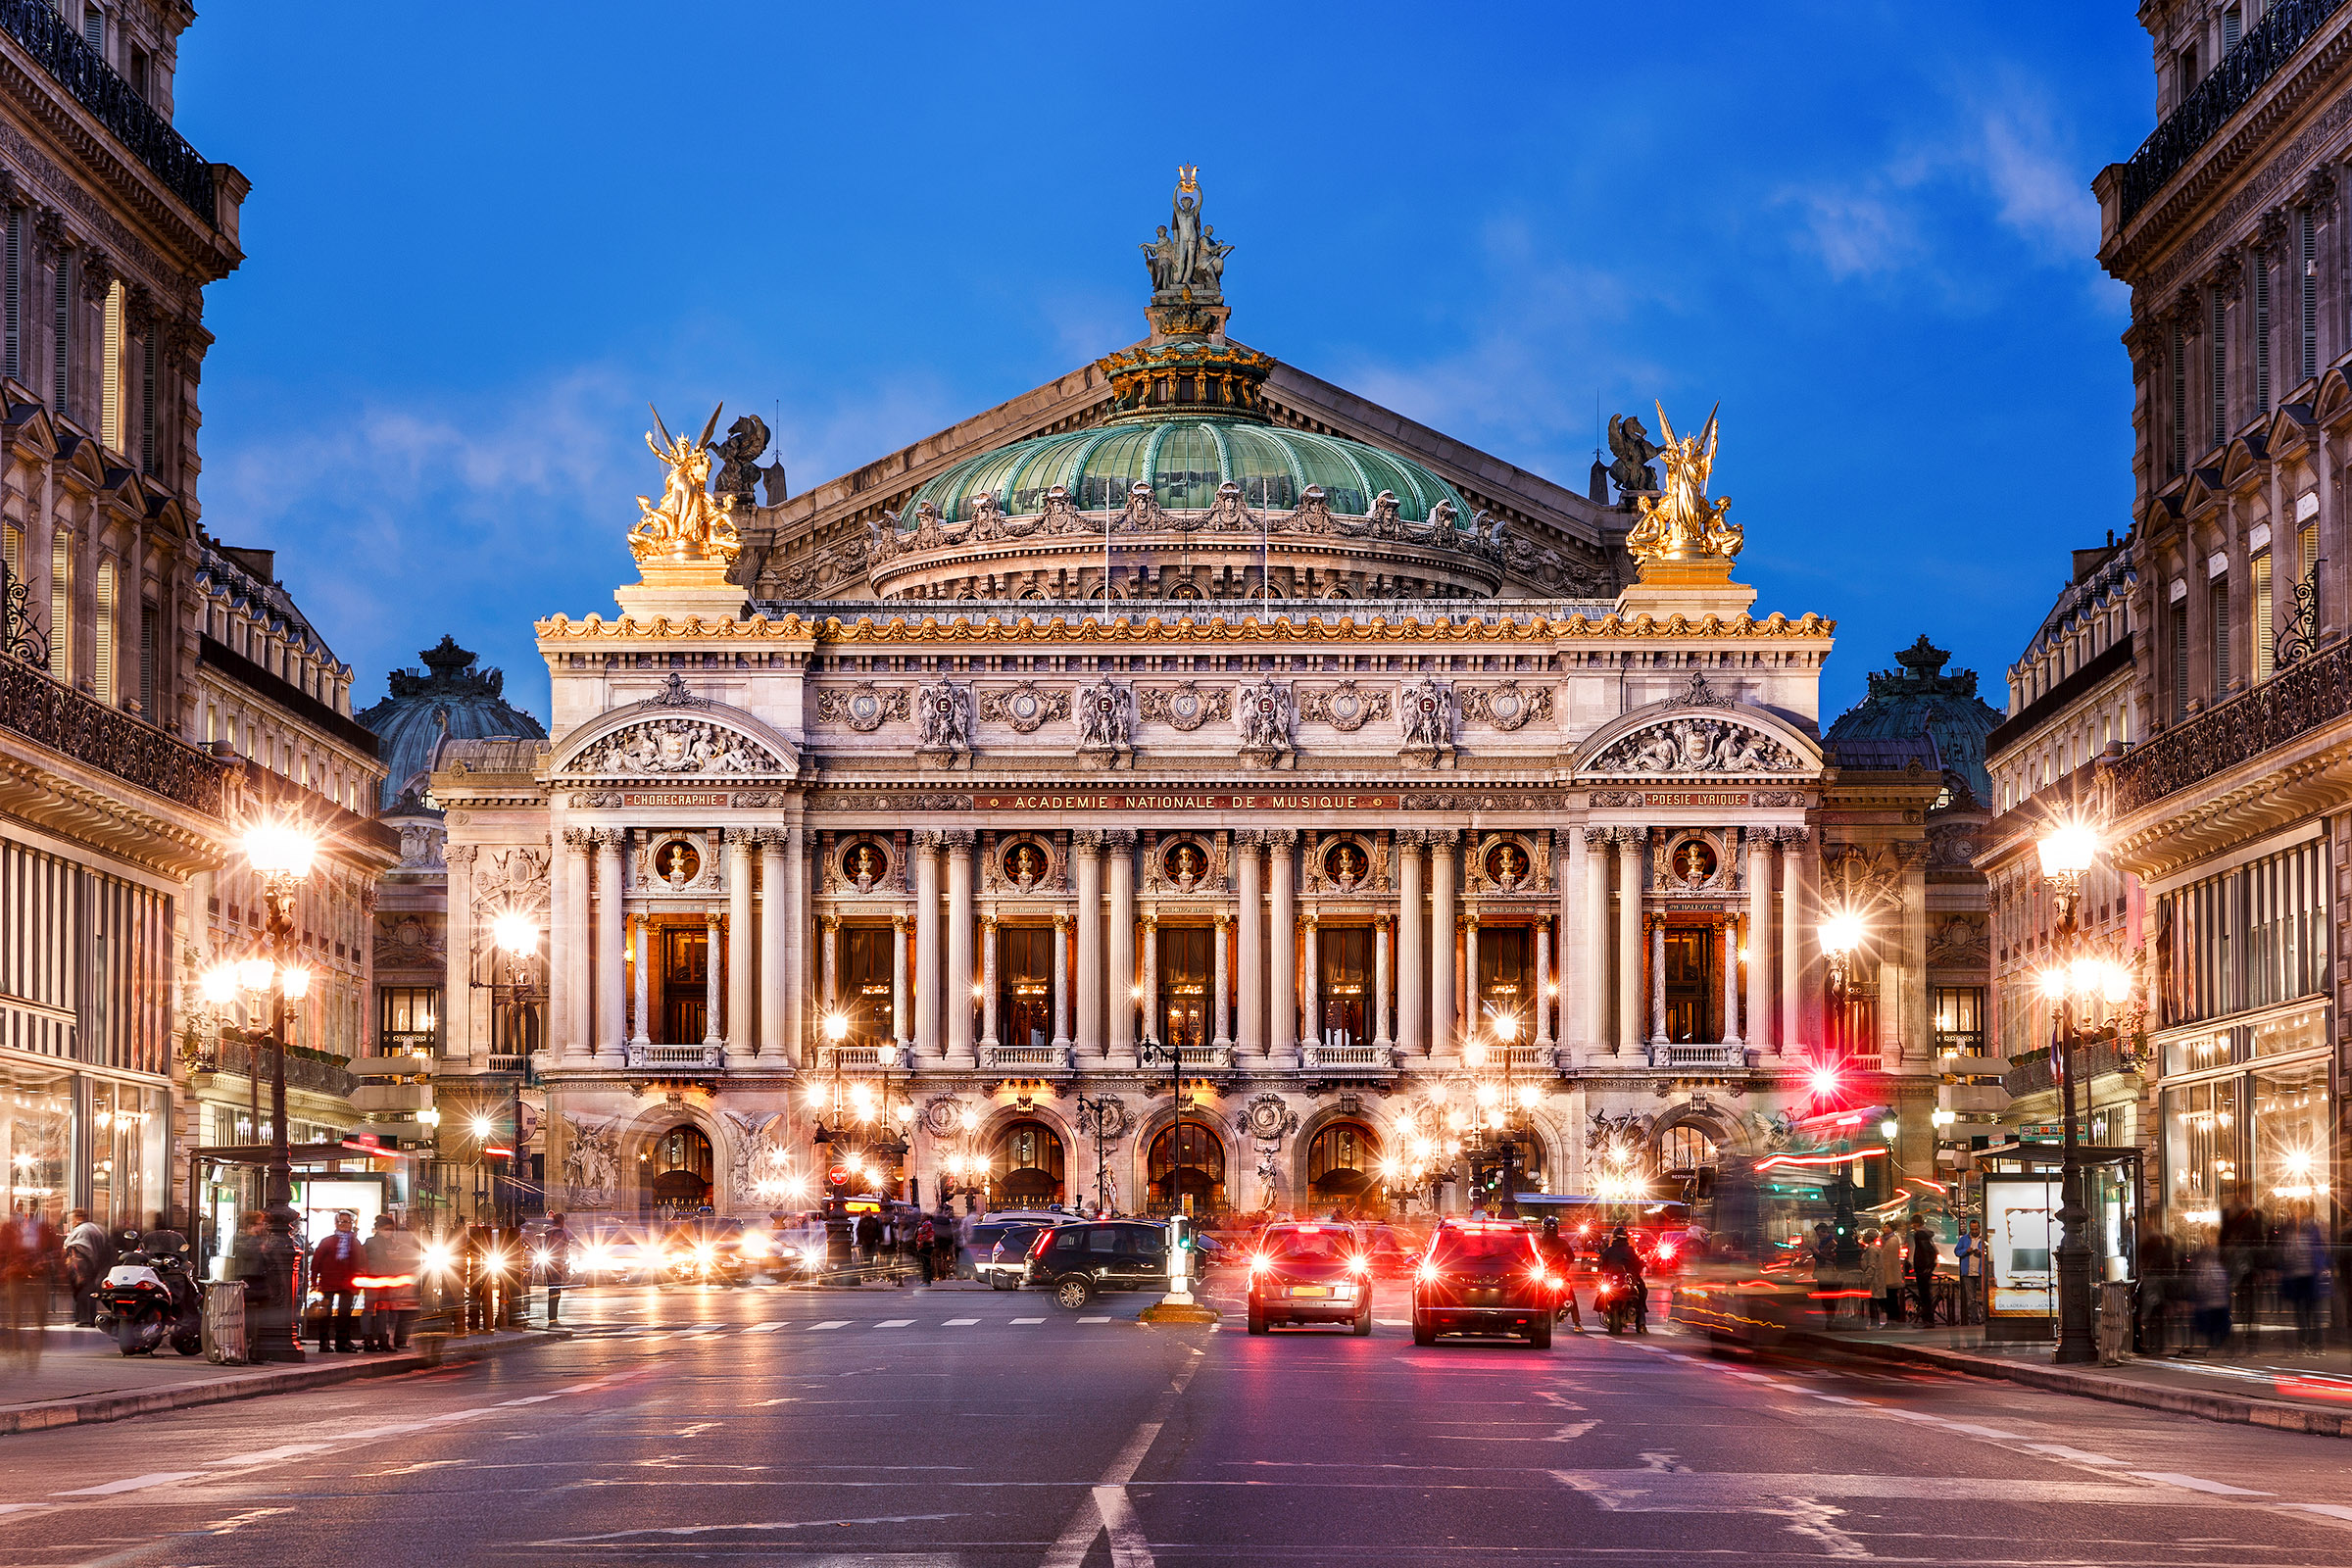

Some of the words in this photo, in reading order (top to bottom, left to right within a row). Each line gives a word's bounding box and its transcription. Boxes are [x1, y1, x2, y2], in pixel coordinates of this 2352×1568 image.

[858, 701, 869, 712] N
[939, 702, 948, 710] E
[1020, 701, 1030, 712] N
[1101, 702, 1109, 710] E
[1181, 701, 1191, 711] N
[1261, 702, 1270, 710] E
[1343, 701, 1352, 711] N
[1423, 702, 1432, 710] E
[1501, 701, 1511, 711] N
[633, 794, 717, 806] CHOREGRAPHIE
[1014, 796, 1108, 808] ACADEMIE
[1125, 796, 1215, 808] NATIONALE
[1232, 796, 1256, 808] DE
[1272, 796, 1357, 808] MUSIQUE
[1652, 794, 1691, 806] POESIE
[1697, 794, 1741, 806] LYRIQUE
